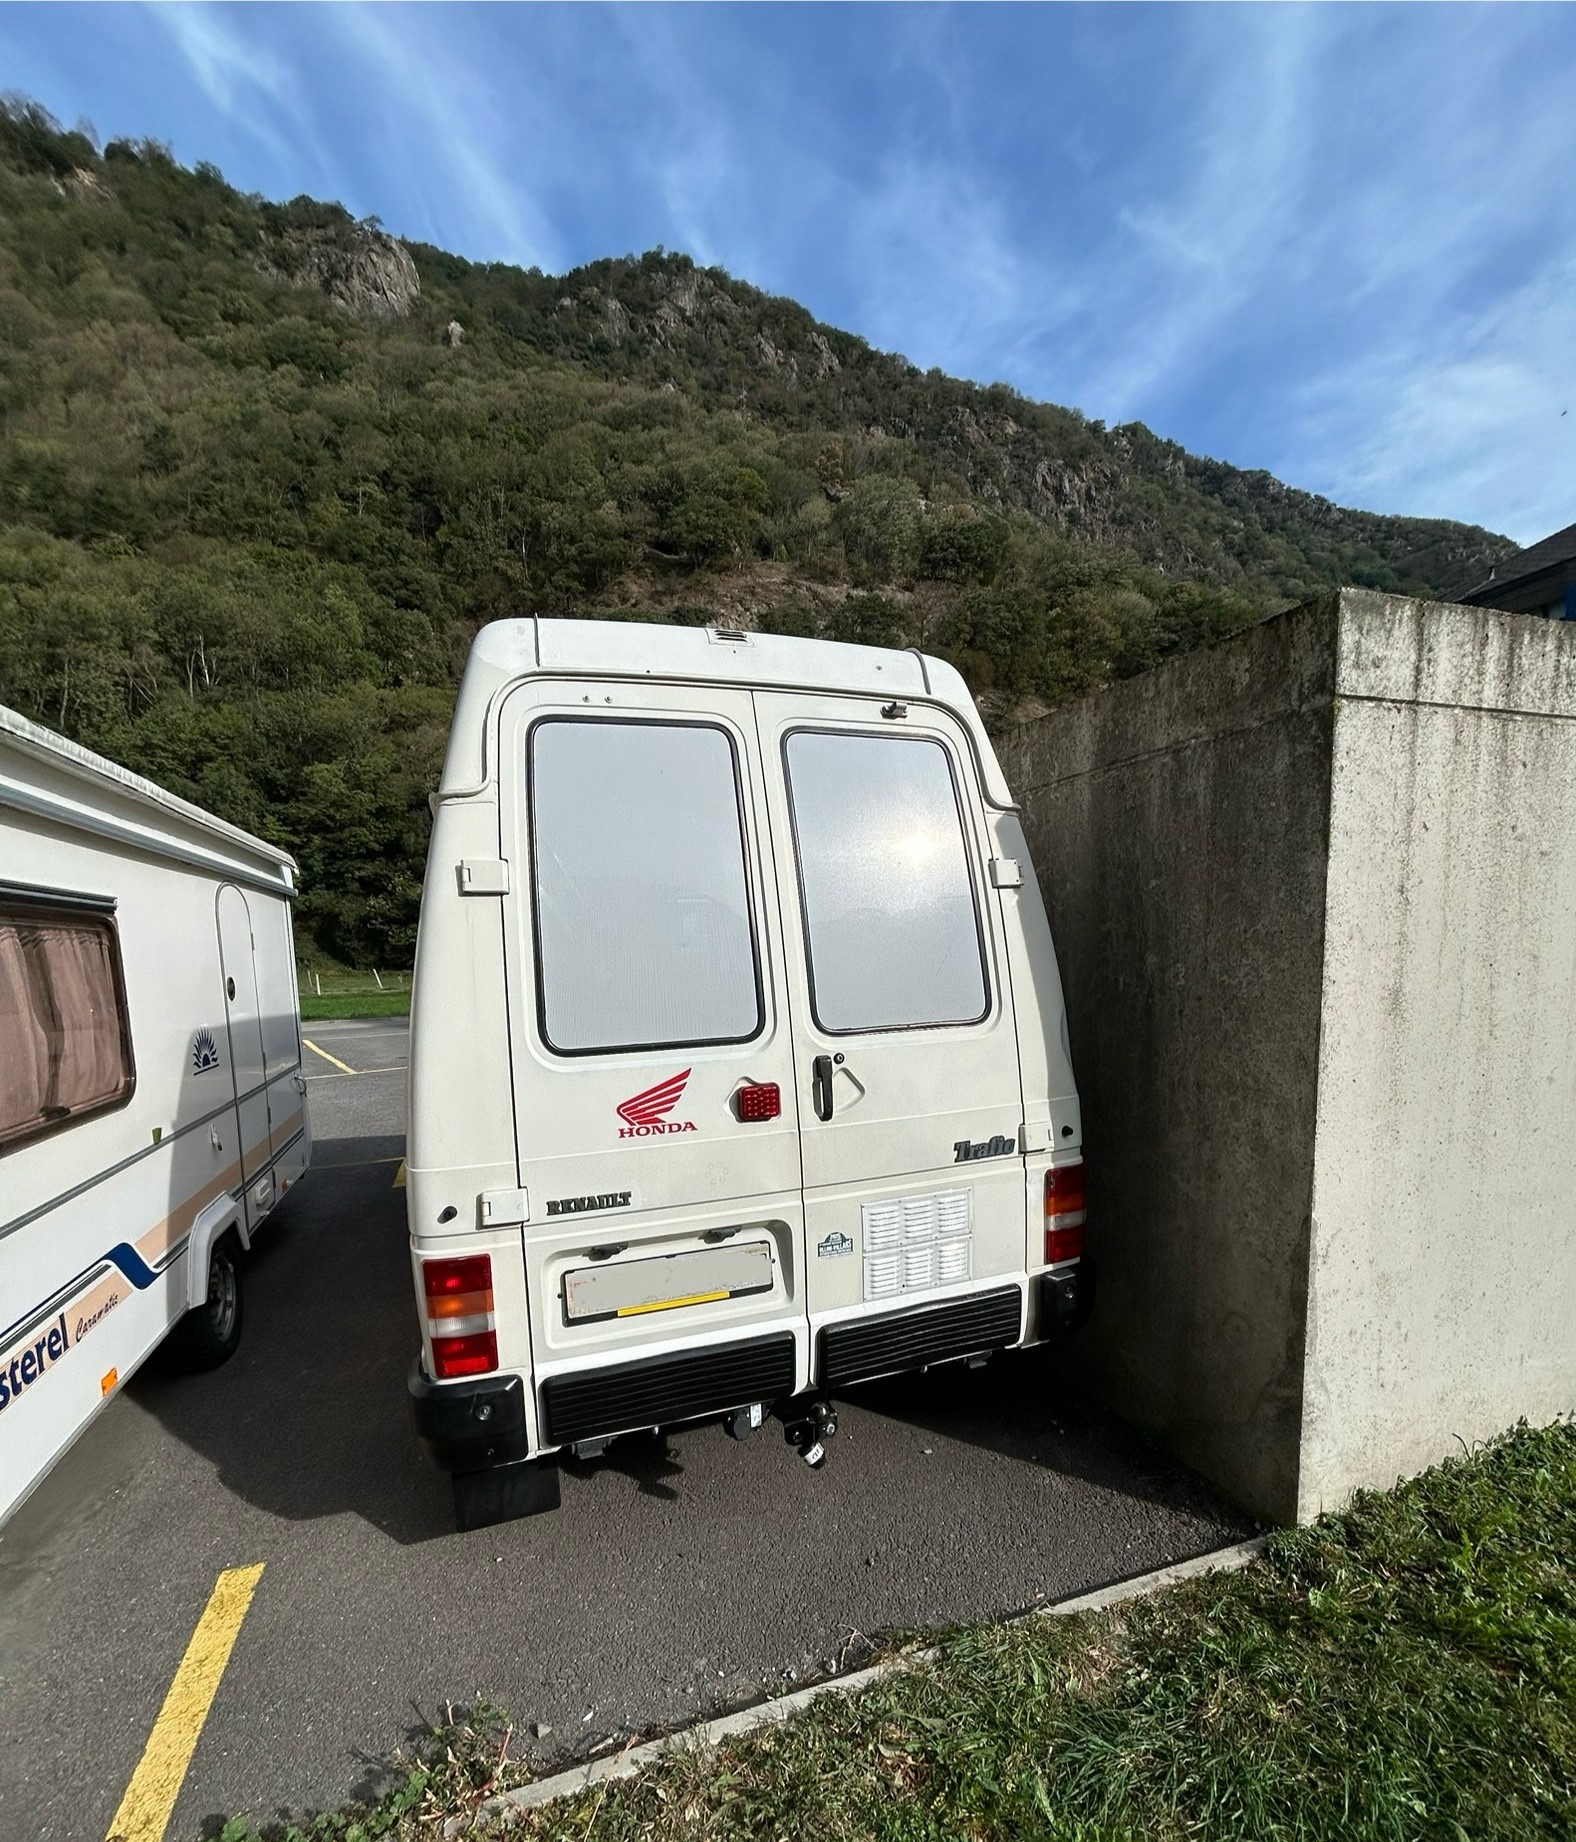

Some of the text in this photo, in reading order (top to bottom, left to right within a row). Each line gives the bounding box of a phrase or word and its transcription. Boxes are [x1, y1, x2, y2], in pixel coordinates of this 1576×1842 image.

[618, 1121, 698, 1138] HONDA
[953, 1135, 1015, 1163] Trafic
[546, 1191, 632, 1216] RENAULT
[0, 1312, 70, 1411] sterel
